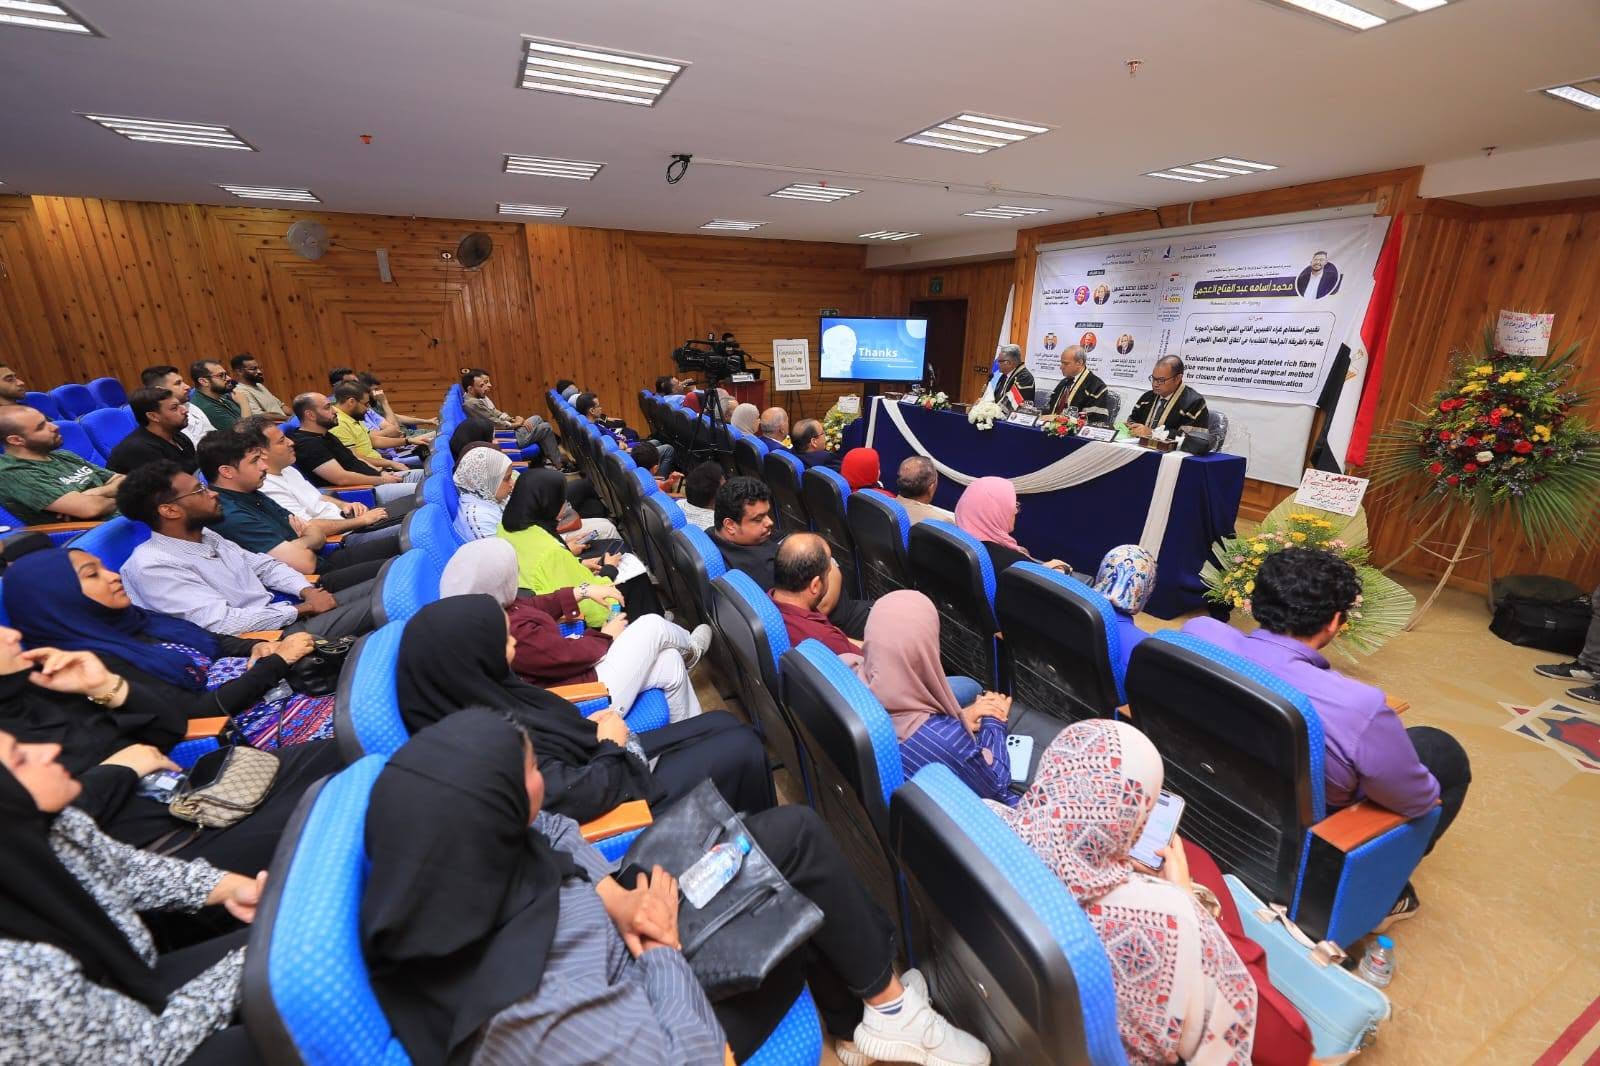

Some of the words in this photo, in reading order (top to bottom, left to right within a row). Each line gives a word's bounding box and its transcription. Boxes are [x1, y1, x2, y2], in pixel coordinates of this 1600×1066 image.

[1271, 282, 1293, 291] محمد
[859, 347, 897, 358] Thanks
[1185, 354, 1214, 363] Evaluation
[1223, 357, 1256, 366] autologous
[1258, 358, 1283, 367] platelet
[1299, 360, 1317, 368] fibrin
[1228, 366, 1260, 375] traditional
[1260, 368, 1287, 378] surgical
[1288, 370, 1314, 378] method
[1224, 375, 1252, 384] oroantral
[1254, 378, 1303, 388] communication
